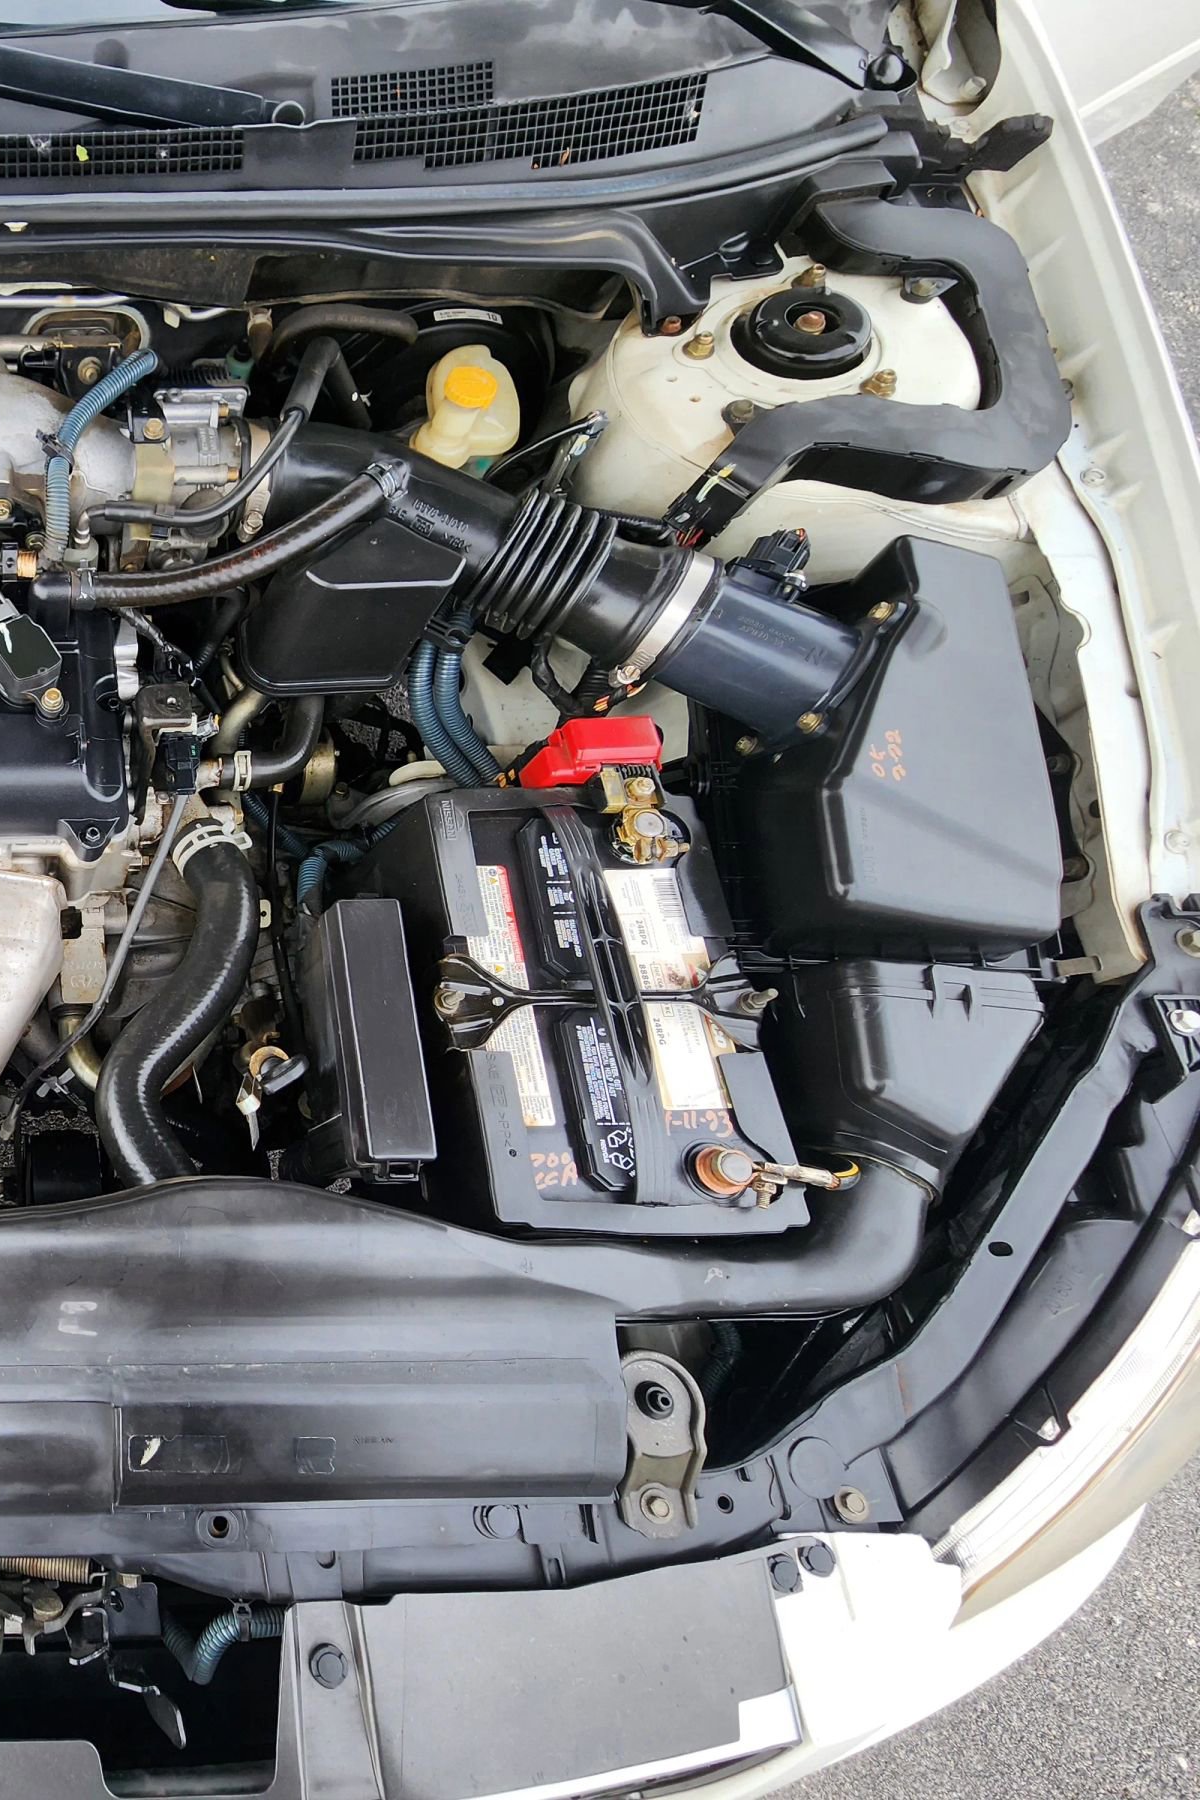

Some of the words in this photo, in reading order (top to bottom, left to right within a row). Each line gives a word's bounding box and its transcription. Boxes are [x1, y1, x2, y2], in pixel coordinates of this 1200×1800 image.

[441, 800, 457, 841] NISSAN
[598, 1041, 609, 1065] MEDICAL
[485, 1053, 500, 1080] SAE
[604, 1066, 612, 1082] HELP
[607, 1082, 616, 1098] FAST
[599, 1138, 609, 1164] RECYCLE
